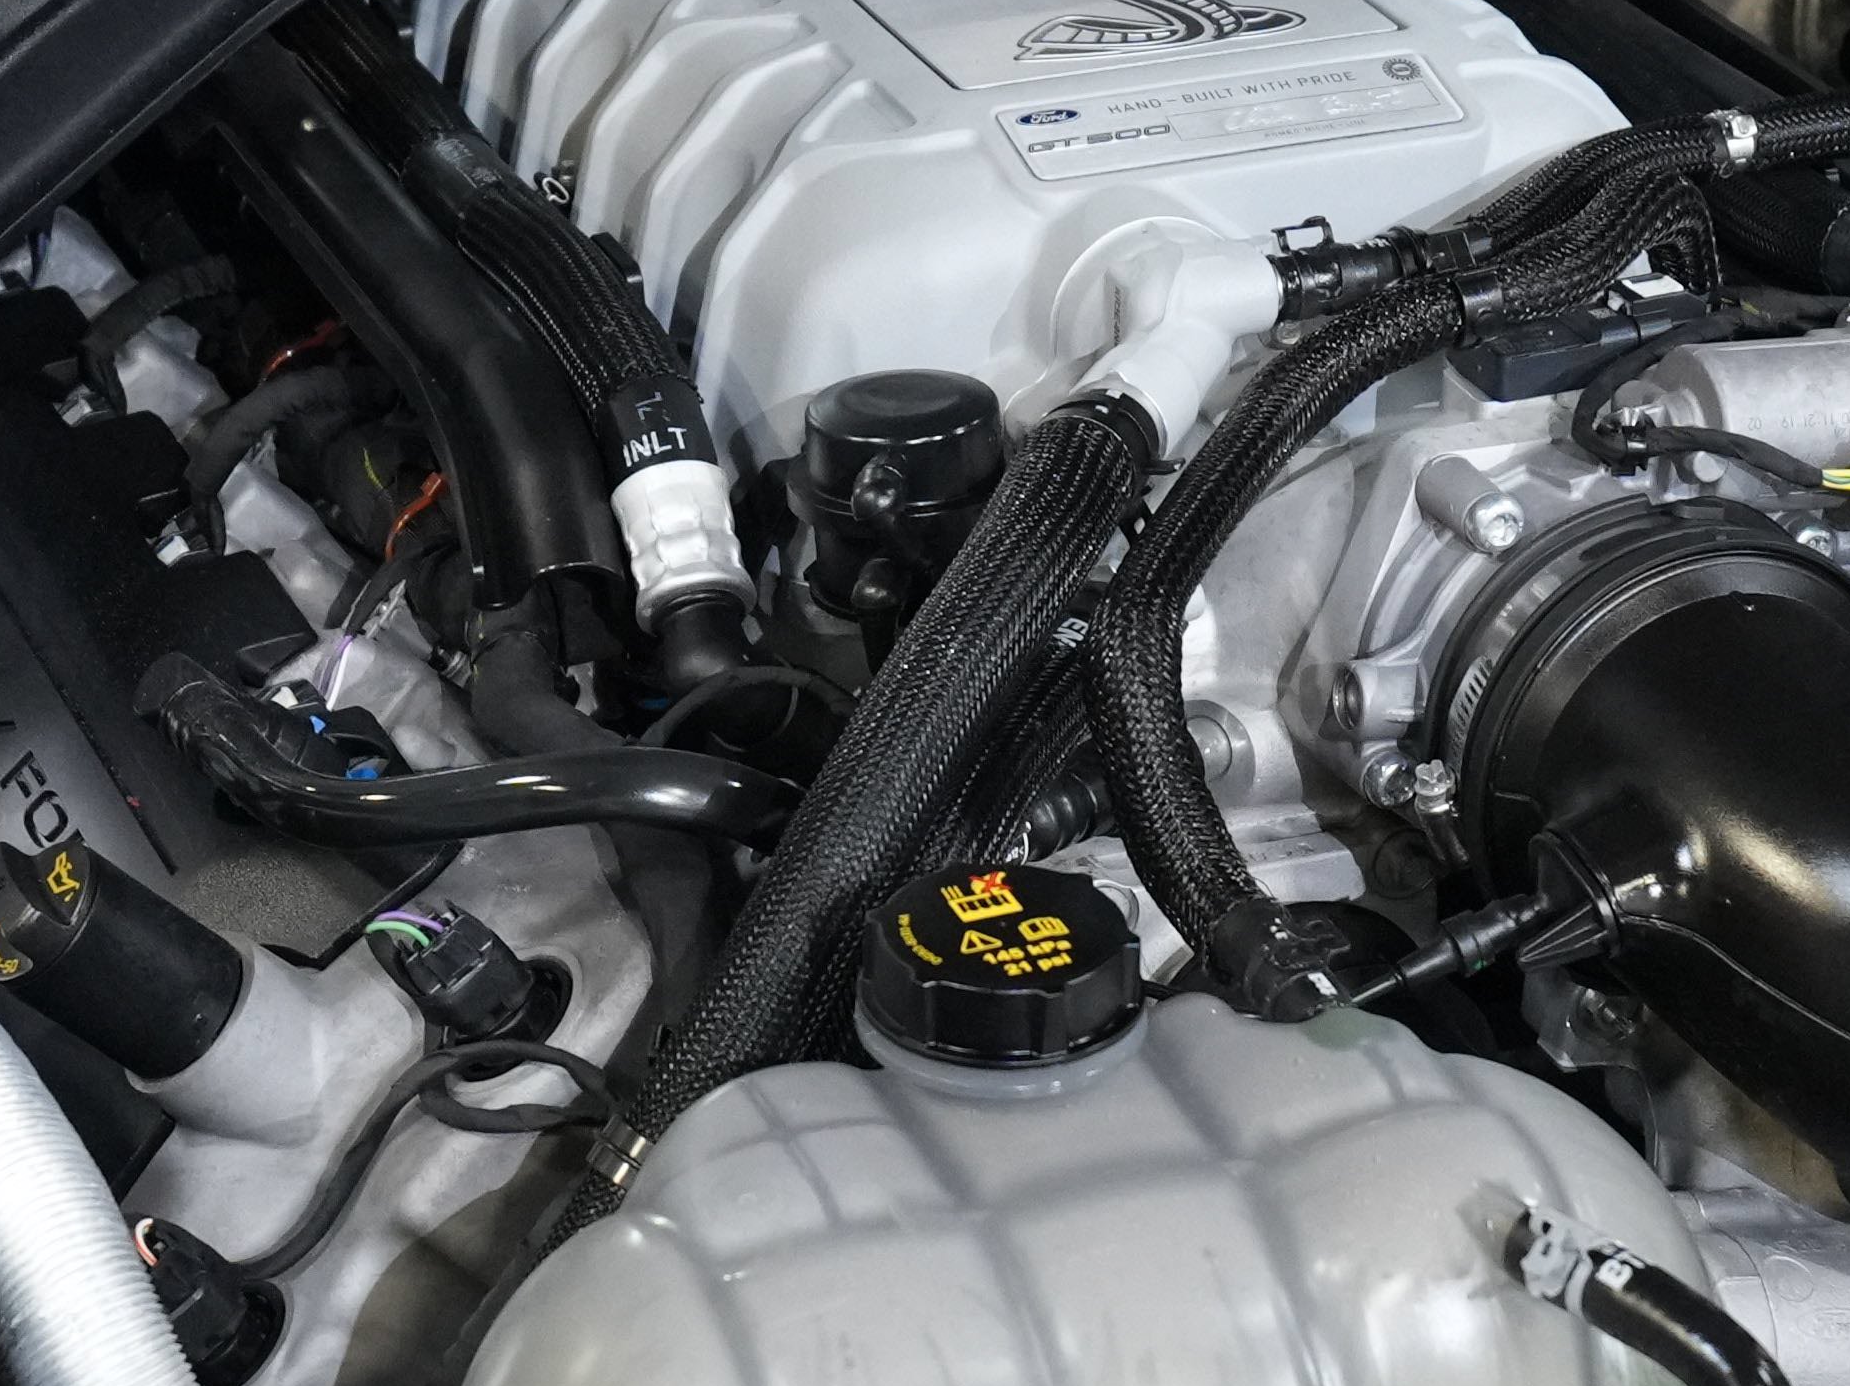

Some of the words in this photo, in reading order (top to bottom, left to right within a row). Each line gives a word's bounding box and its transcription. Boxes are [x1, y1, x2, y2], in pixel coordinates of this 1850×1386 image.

[1241, 79, 1292, 95] WITH
[1297, 71, 1357, 87] PRIDE
[622, 426, 688, 468] INLT
[982, 946, 1025, 966] 145
[1025, 939, 1073, 958] kPa
[1002, 959, 1033, 977] 21
[1036, 951, 1074, 973] psi
